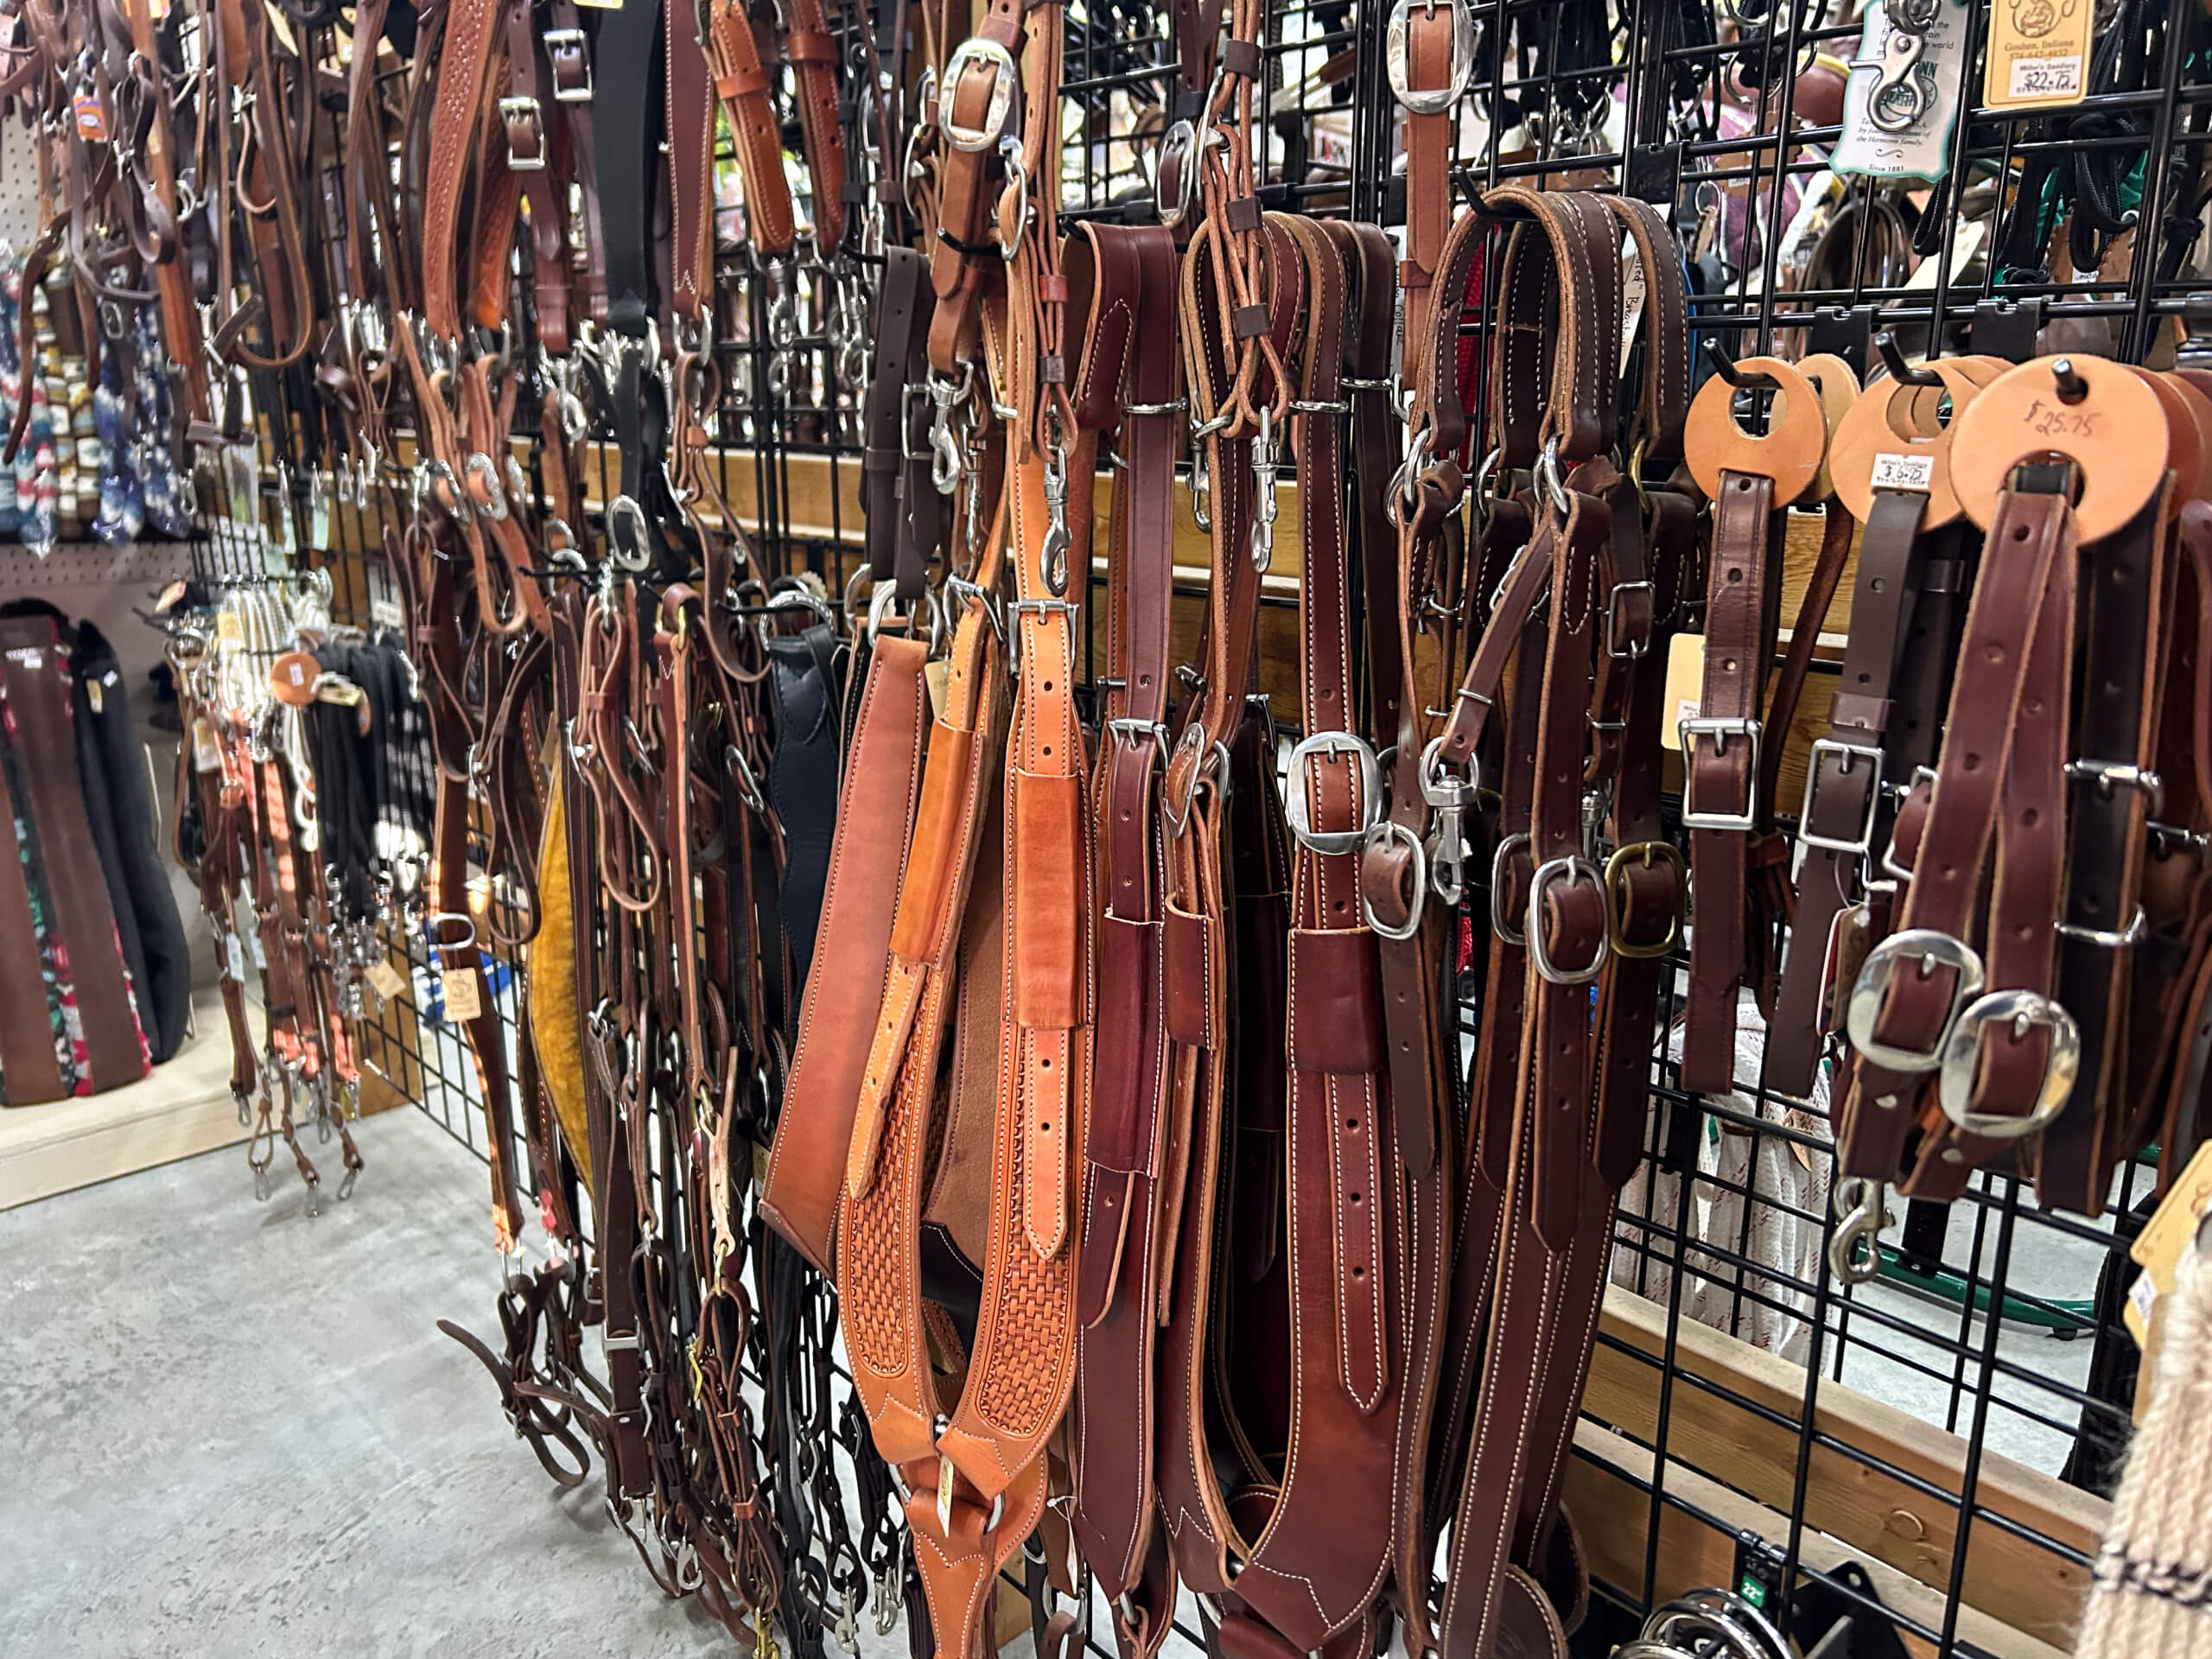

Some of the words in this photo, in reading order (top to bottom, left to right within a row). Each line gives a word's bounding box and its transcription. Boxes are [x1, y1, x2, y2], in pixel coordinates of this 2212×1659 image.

[1931, 41, 1955, 50] world
[2035, 409, 2103, 438] 25.75
[1743, 1582, 1762, 1599] 22"
